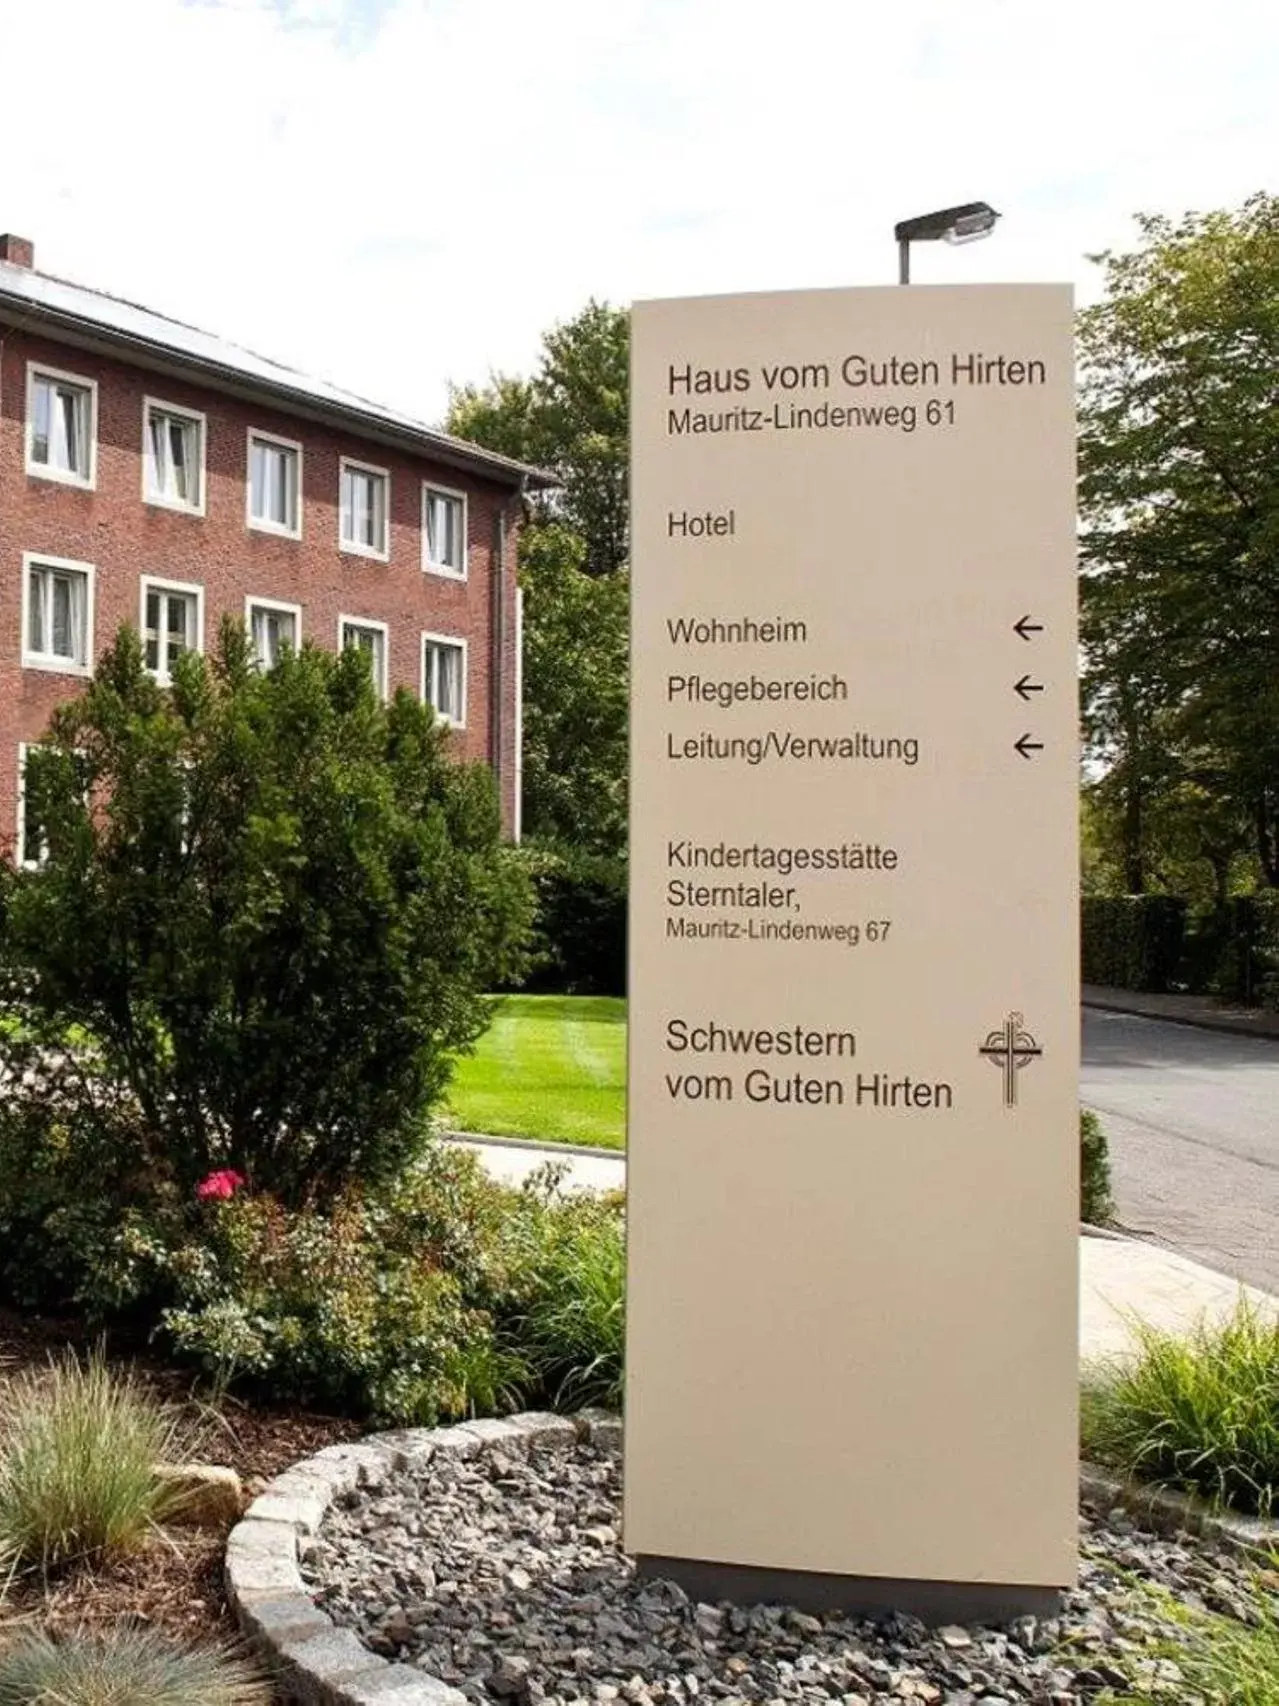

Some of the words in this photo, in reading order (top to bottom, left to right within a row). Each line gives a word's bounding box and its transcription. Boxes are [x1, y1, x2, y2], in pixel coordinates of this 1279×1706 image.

[668, 363, 751, 396] Haus
[761, 364, 830, 391] vom
[841, 354, 939, 388] Guten
[951, 353, 1046, 386] Hirten
[668, 401, 917, 435] Mauritz-Lindenweg
[925, 398, 954, 426] 61
[668, 509, 735, 537] Hotel
[666, 616, 807, 645] Wohnheim
[667, 674, 848, 709] Pflegebereich
[667, 731, 919, 766] Leitung/Verwaltung
[667, 841, 898, 876] Kindertagesstätte
[666, 879, 801, 913] Sterntaler,
[664, 917, 860, 947] Mauritz-Lindenweg
[865, 920, 891, 942] 67
[666, 1019, 856, 1057] Schwestern
[665, 1074, 733, 1101] vom
[744, 1068, 844, 1105] Guten
[856, 1073, 953, 1109] Hirten
